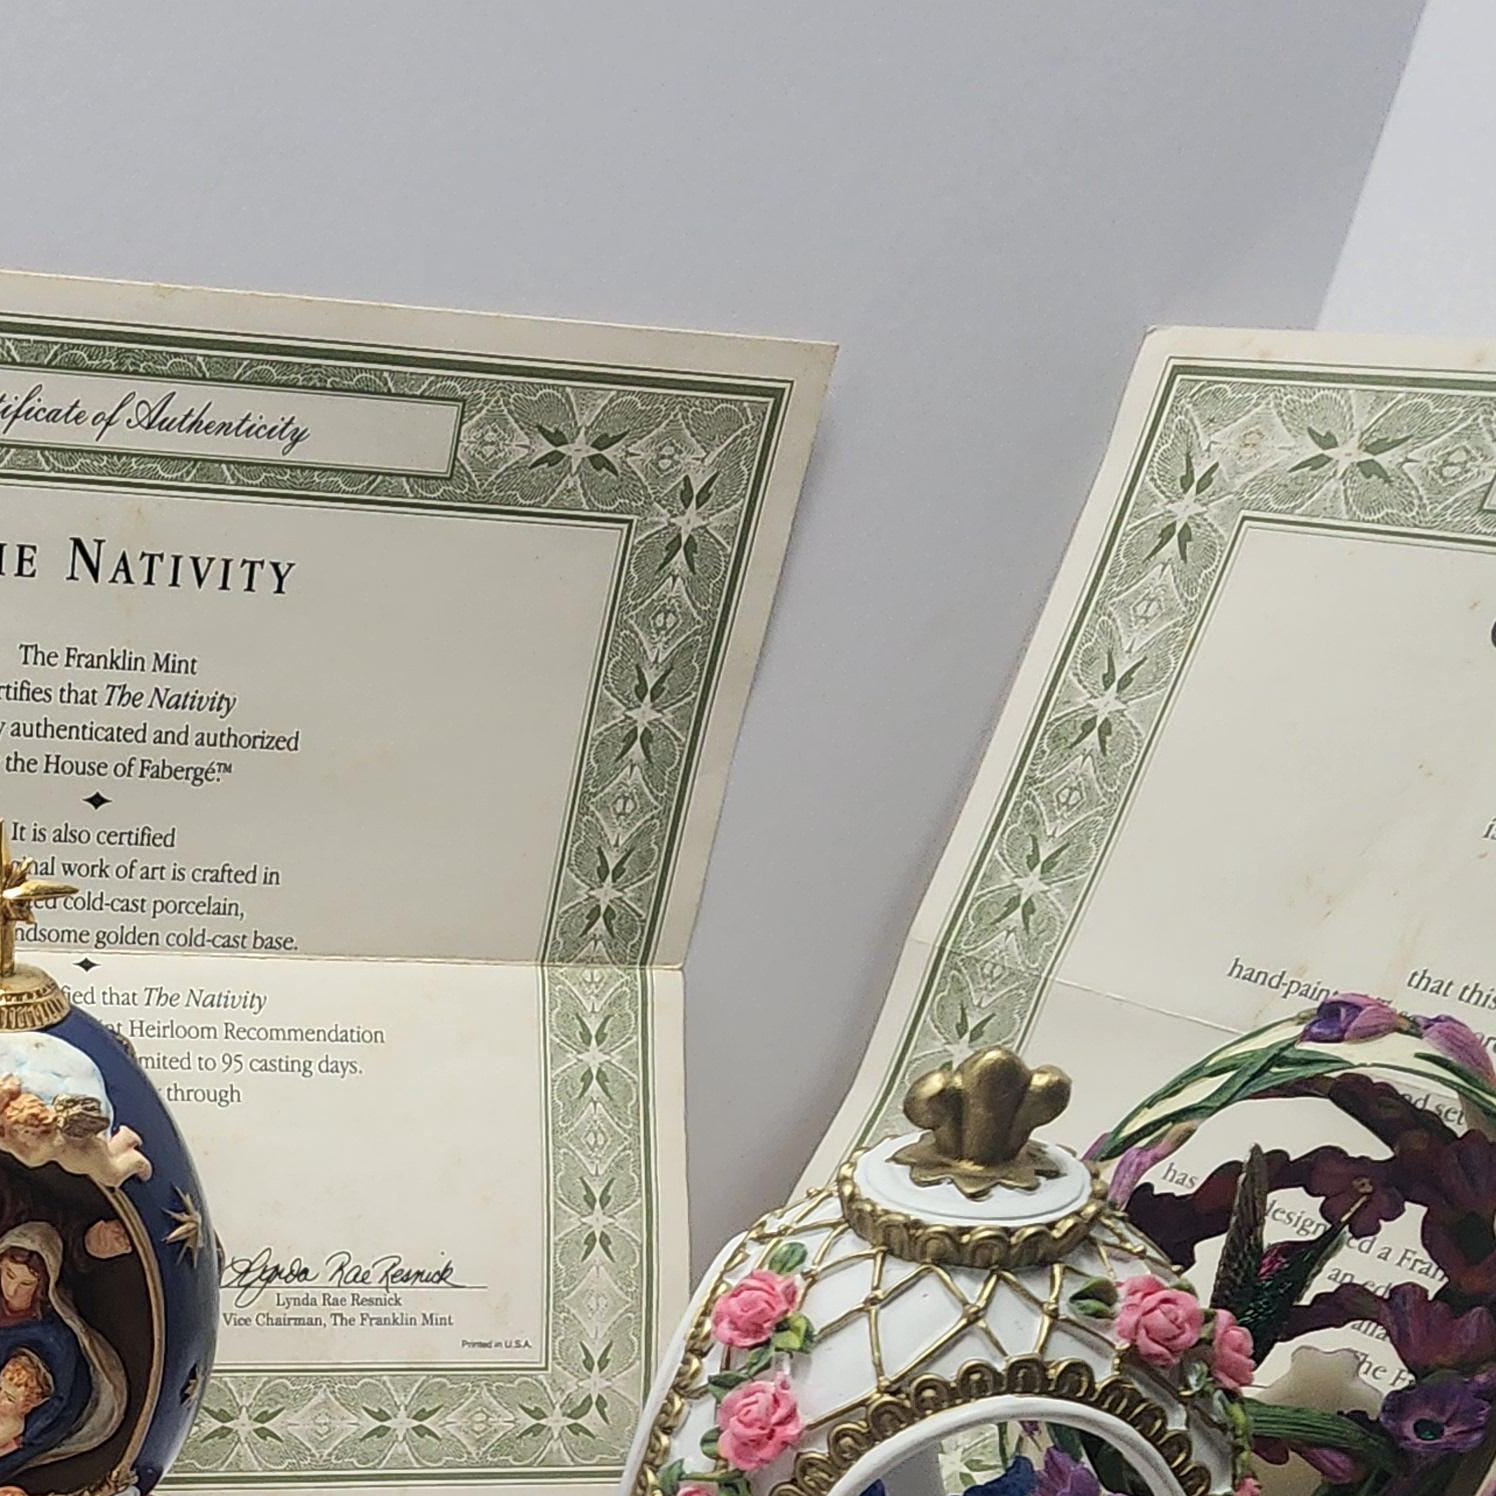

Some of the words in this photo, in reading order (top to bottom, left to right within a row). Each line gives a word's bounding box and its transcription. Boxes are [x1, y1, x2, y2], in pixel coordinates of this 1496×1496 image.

[92, 391, 136, 441] of
[127, 392, 310, 456] Authenticity
[66, 537, 295, 594] NATIVITY
[19, 644, 59, 667] The
[64, 647, 145, 672] Franklin
[152, 652, 197, 675] Mint
[60, 682, 97, 705] that
[105, 684, 144, 708] The
[148, 687, 236, 719] Nativity
[10, 717, 147, 743] authenticated
[153, 725, 189, 745] and
[195, 727, 299, 751] authorized
[6, 751, 38, 773] the
[43, 754, 108, 776] House
[113, 757, 136, 777] of
[53, 823, 90, 844] also
[97, 826, 175, 847] certified
[62, 858, 110, 878] work
[116, 859, 138, 879] of
[140, 866, 166, 880] art
[192, 863, 257, 884] crafted
[63, 891, 146, 914] cold-cast
[152, 896, 243, 920] porcelain,
[13, 924, 90, 947] ndsome
[94, 925, 160, 950] golden
[165, 928, 247, 949] cold-cast
[253, 930, 298, 950] base.
[1407, 968, 1454, 997] that
[102, 987, 138, 1006] that
[144, 987, 180, 1007] The
[185, 989, 267, 1015] Nativity
[129, 1020, 217, 1039] Heirloom
[224, 1023, 384, 1043] Recommendation
[137, 1053, 192, 1072] mited
[250, 1055, 313, 1077] casting
[318, 1055, 362, 1078] days.
[167, 1083, 241, 1107] through
[1161, 1162, 1198, 1189] has
[1377, 1244, 1389, 1261] a
[325, 1251, 371, 1287] Rae
[372, 1251, 467, 1293] Resnick
[276, 1293, 317, 1309] Lynda
[322, 1293, 346, 1306] Rae
[350, 1293, 402, 1306] Resnick
[223, 1314, 252, 1326] Vice
[256, 1313, 326, 1328] Chairman,
[330, 1313, 355, 1326] The
[360, 1313, 417, 1326] Franklin
[421, 1313, 453, 1326] Mint
[462, 1340, 492, 1348] Printed
